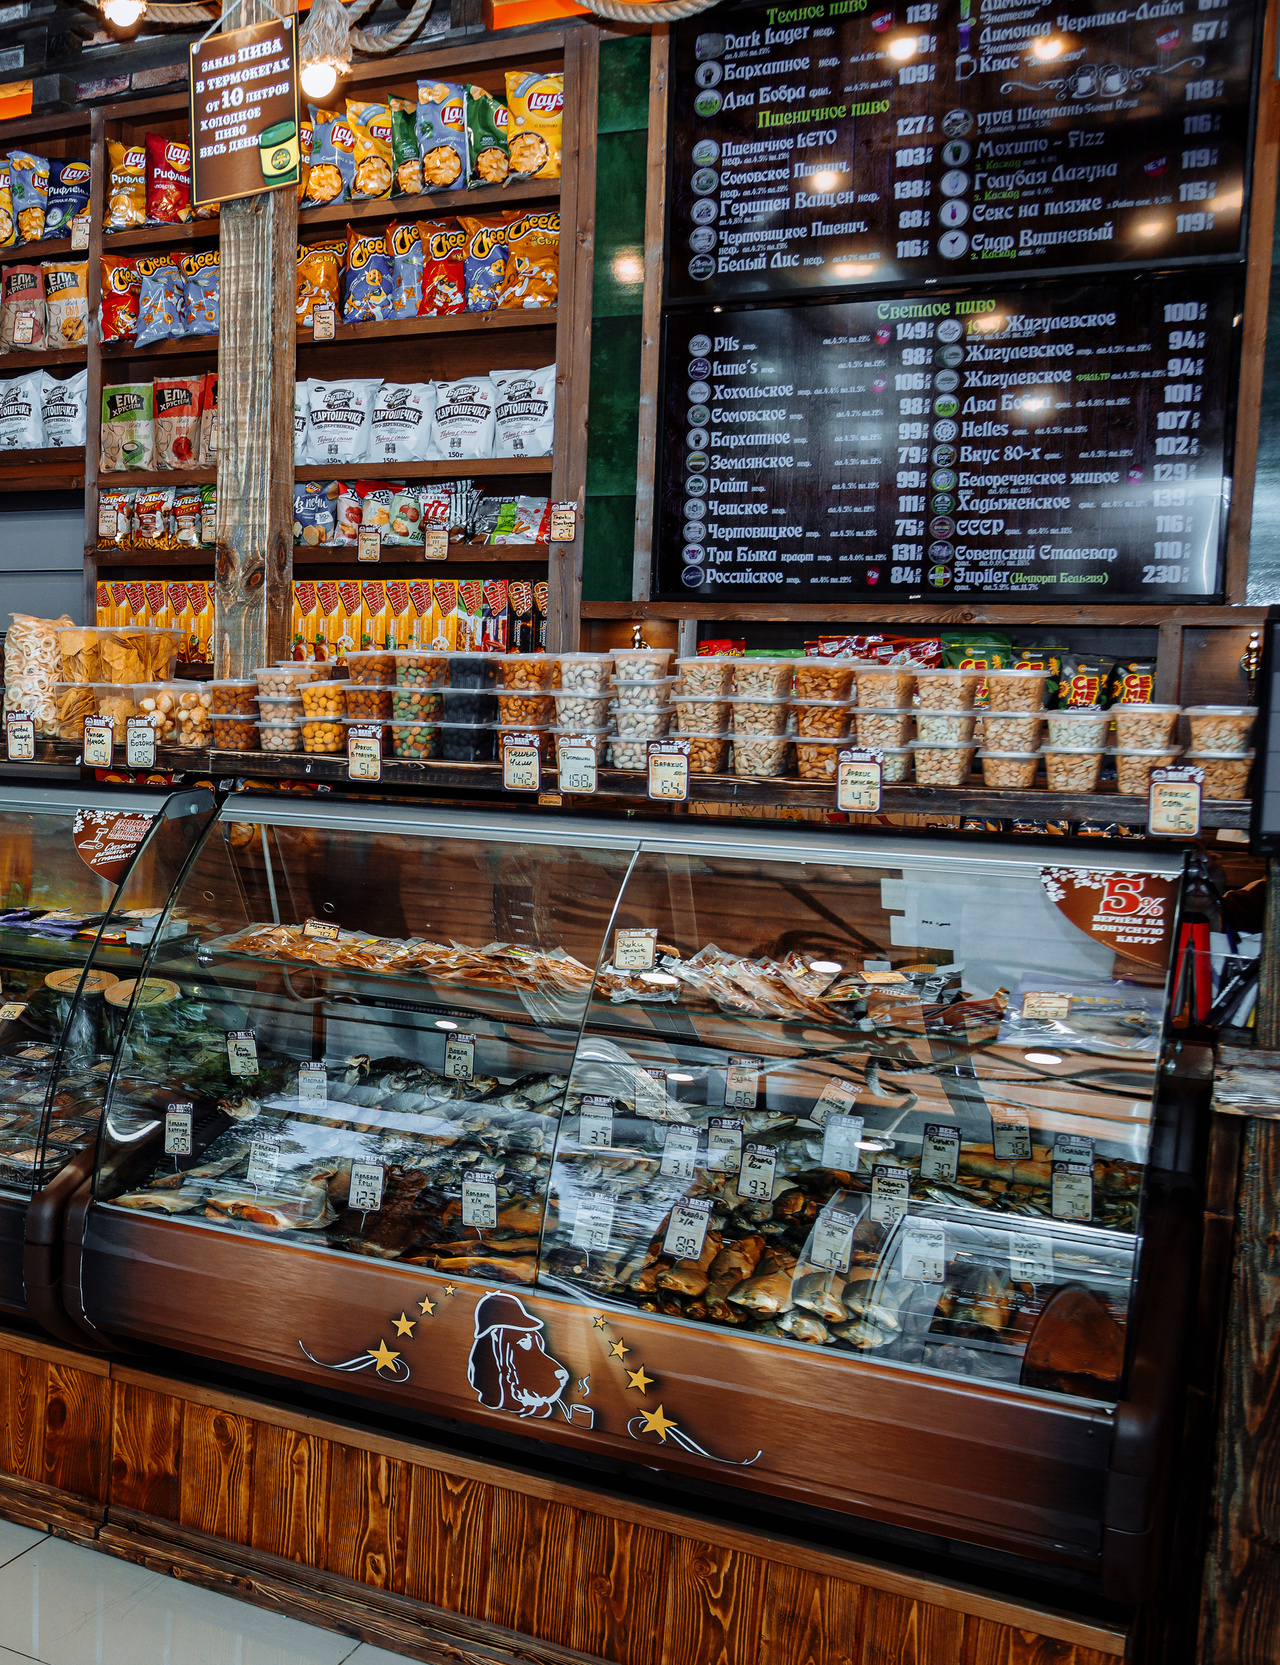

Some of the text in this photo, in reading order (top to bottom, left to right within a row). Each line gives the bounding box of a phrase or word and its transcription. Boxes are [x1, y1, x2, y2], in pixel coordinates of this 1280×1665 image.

[766, 0, 868, 25] Темное пиво
[906, 3, 930, 24] 113
[725, 25, 809, 51] Dark Lager
[979, 21, 1052, 45] Лимонад
[201, 37, 283, 72] ЗАКАЗ ПИВА
[979, 54, 1019, 73] Квас
[196, 58, 290, 94] В ТЕРМОКЕГАХ
[723, 55, 810, 81] Бархатное
[898, 65, 929, 85] 109
[205, 82, 290, 113] ОТ 10 ЛИТРОВ
[722, 85, 806, 111] Два Бобра
[200, 107, 261, 131] ХОЛОДНОЕ
[757, 99, 890, 129] Пшеничное пиво
[1018, 105, 1083, 124] Шампань
[215, 124, 247, 141] ПИВО
[897, 116, 928, 136] 127
[199, 143, 227, 159] ВЕСЬ
[722, 138, 794, 157] Пшеничное
[975, 137, 1048, 160] Мохито
[896, 148, 926, 168] 103
[720, 168, 790, 186] Сомовское
[974, 161, 1119, 191] Голубая Лагуна
[720, 189, 854, 216] Герштен Вайцен
[972, 196, 1103, 223] Секс на пляже
[719, 221, 868, 246] Чертовицкое Пшенич.
[971, 221, 1114, 253] Сидр Вишневый
[718, 251, 800, 273] Белый Лис
[877, 299, 996, 320] Светлое пиво
[1164, 302, 1198, 323] 100
[896, 322, 926, 341] 149
[1005, 312, 1117, 335] Жигулевское
[713, 337, 740, 353] Pils
[1169, 331, 1196, 350] 94
[902, 348, 925, 366] 98
[965, 343, 1074, 363] Жигулевское
[1167, 358, 1196, 377] 94
[895, 373, 925, 391] 106
[963, 369, 1072, 389] Жигулевское
[713, 384, 793, 401] Хохольское
[1164, 384, 1194, 404] 101
[436, 406, 491, 422] КАРТОШЕЧКА
[900, 398, 924, 415] 98
[961, 396, 996, 415] Два
[310, 410, 364, 426] КАРТОШЕЧКА
[711, 408, 786, 424] Сомовское
[1157, 410, 1191, 430] 107
[898, 423, 923, 440] 99
[961, 422, 1009, 438] Helles
[710, 432, 791, 449] Бархатное
[710, 455, 793, 470] Землянское
[898, 447, 921, 464] 79
[959, 445, 1002, 464] Вкус
[709, 477, 748, 493] Райт
[896, 471, 920, 489] 99
[959, 470, 1119, 488] Белореченское живое
[708, 501, 768, 516] Чешское
[956, 496, 1070, 514] Хадыженское
[708, 523, 803, 541] Чертовицкое
[895, 519, 917, 537] 75
[956, 518, 1005, 536] СССР
[707, 547, 732, 564] Три
[736, 546, 777, 562] Быка
[954, 544, 1118, 563] Советский Сталевар
[706, 568, 783, 585] Российское
[890, 567, 914, 584] 84
[1142, 565, 1181, 583] 230
[1099, 876, 1166, 916] 5%
[1092, 924, 1164, 935] БОНУСНУЮ
[1145, 918, 1164, 926] НА
